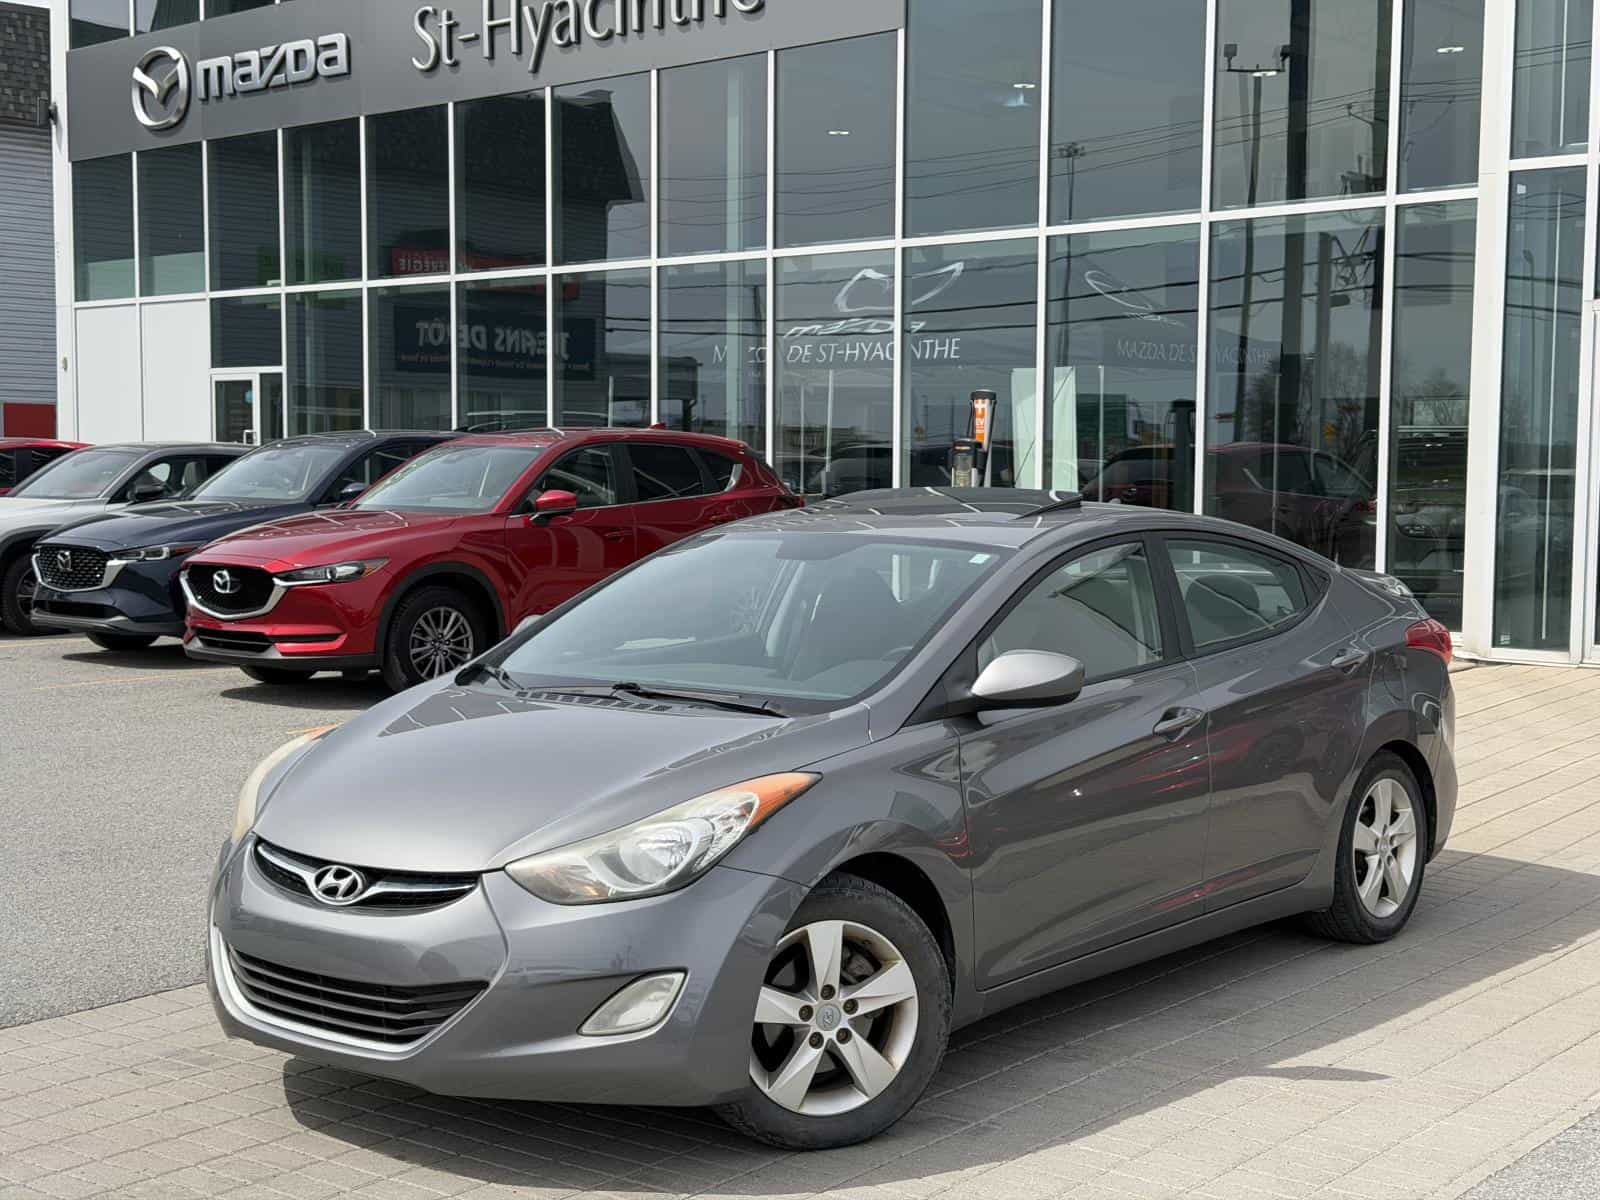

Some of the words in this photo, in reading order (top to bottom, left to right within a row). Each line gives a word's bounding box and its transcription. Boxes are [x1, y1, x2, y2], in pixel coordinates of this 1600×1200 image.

[411, 0, 765, 73] St-Hyacin
[712, 345, 767, 364] MZD
[786, 345, 814, 363] DE
[816, 338, 961, 362] ST-HYACNTHE
